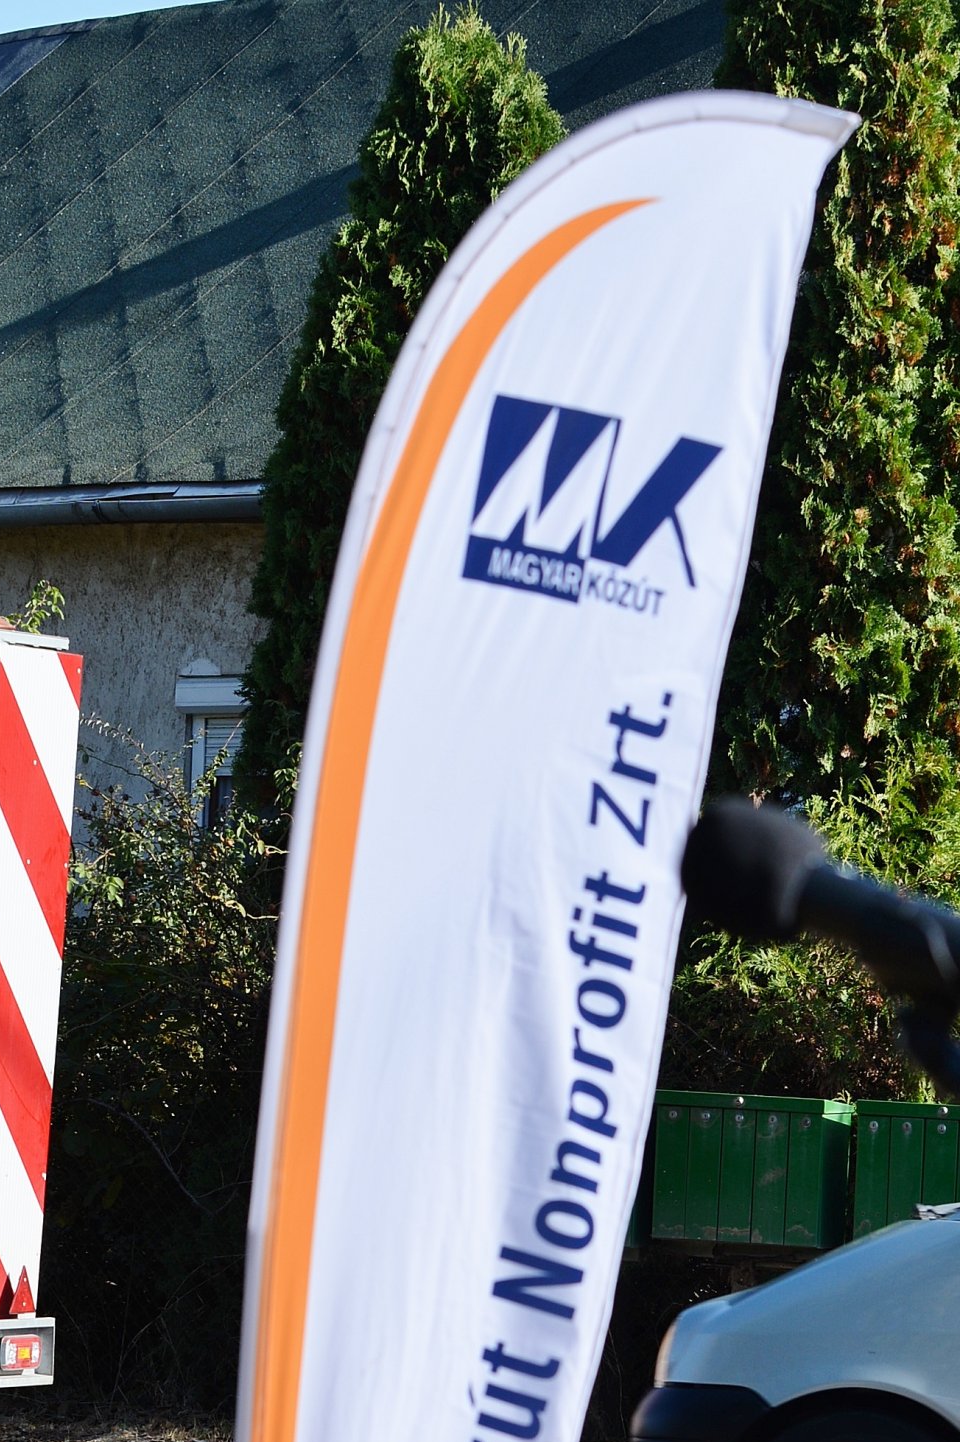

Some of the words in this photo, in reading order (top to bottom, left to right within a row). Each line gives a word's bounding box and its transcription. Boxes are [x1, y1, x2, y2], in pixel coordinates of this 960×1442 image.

[487, 546, 583, 596] MAGYAR
[492, 869, 647, 1320] Nonprofit
[588, 688, 675, 848] Zrt.
